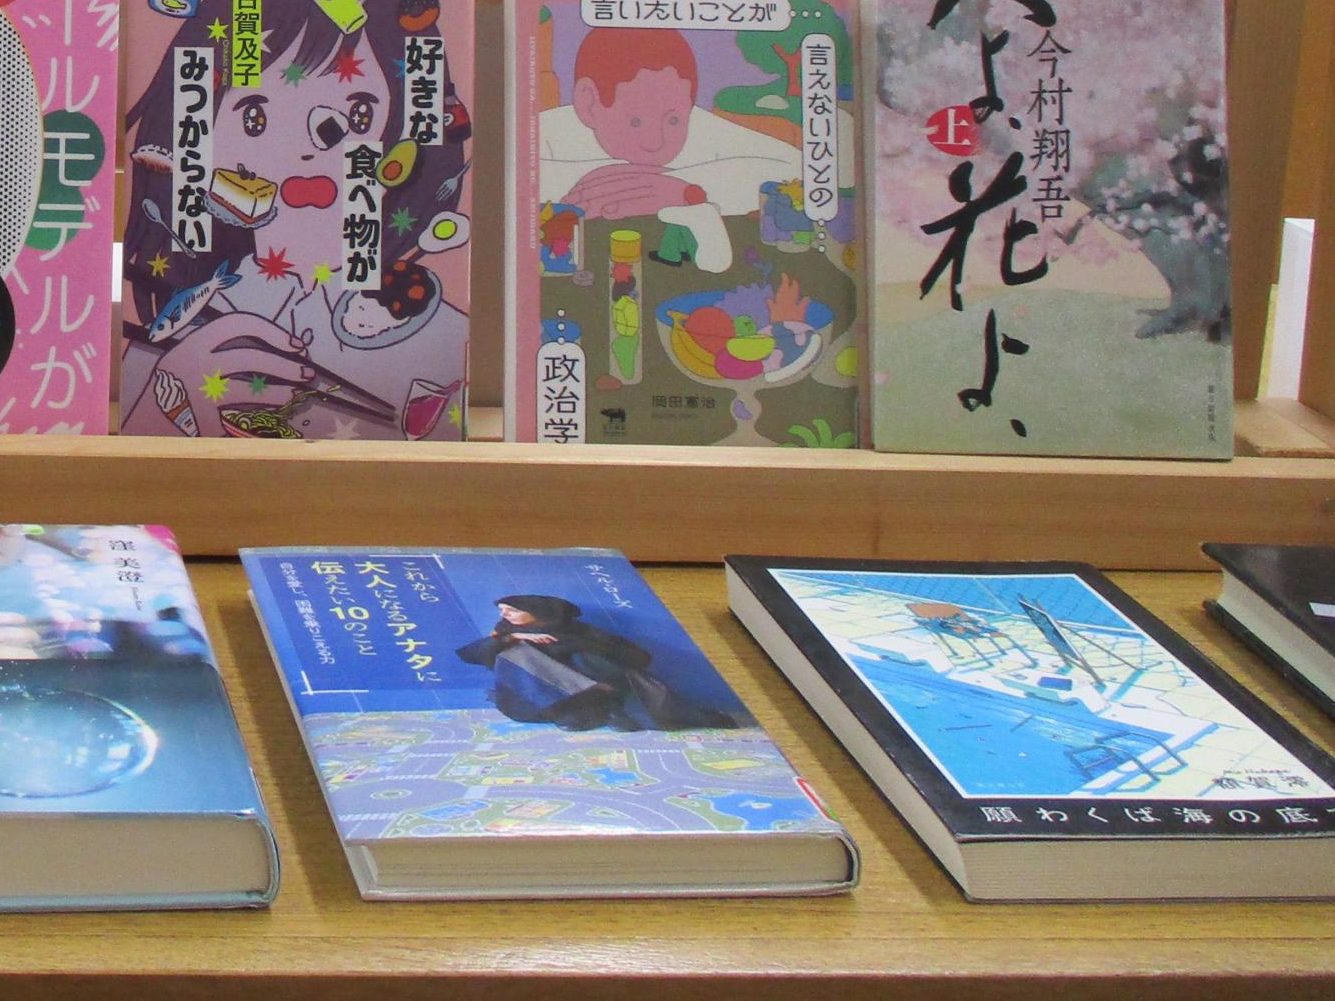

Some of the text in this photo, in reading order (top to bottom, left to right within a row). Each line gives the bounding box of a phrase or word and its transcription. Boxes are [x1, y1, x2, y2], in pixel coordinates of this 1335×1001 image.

[591, 0, 777, 23] 言いたいことが
[406, 37, 443, 145] 好きな
[805, 43, 833, 208] 言えないひとの
[933, 115, 971, 147] 上
[1027, 29, 1071, 222] 今村翔吾
[177, 49, 211, 249] みつからない
[343, 143, 383, 283] 食べ物が
[543, 355, 580, 443] 政治学
[311, 561, 377, 656] 伝えたい10のこと
[354, 561, 442, 682] 大人になるアナタに
[402, 561, 440, 602] これから
[979, 805, 1335, 824] 願わくば海の底
